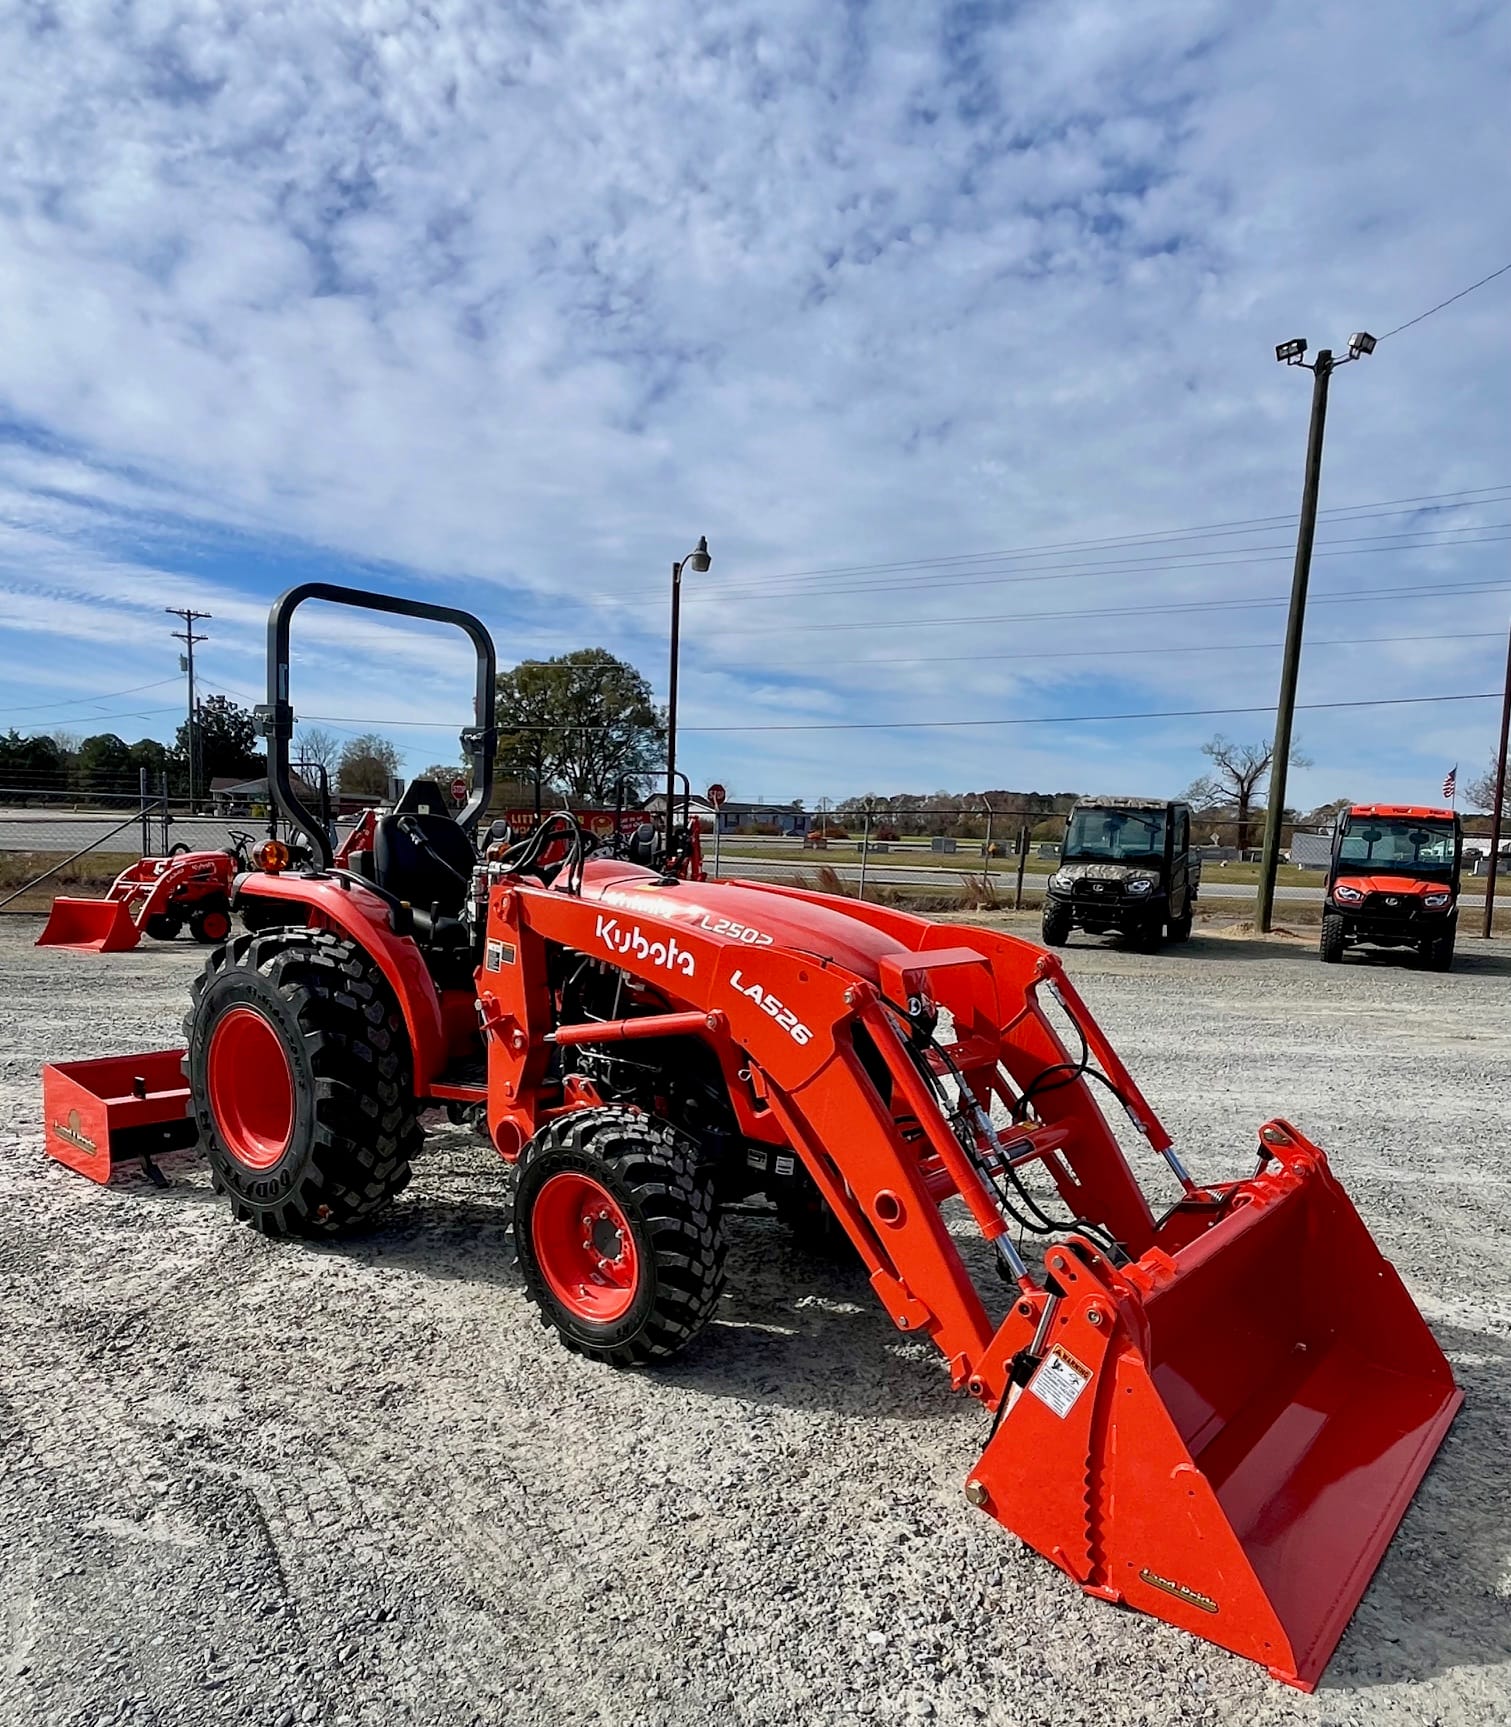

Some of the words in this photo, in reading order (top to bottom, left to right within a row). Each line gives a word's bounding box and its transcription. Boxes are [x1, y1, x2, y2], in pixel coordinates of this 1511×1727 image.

[708, 789, 725, 800] STOP
[595, 914, 696, 977] Kubota
[729, 969, 814, 1045] LA526
[1062, 1353, 1089, 1379] WARNING
